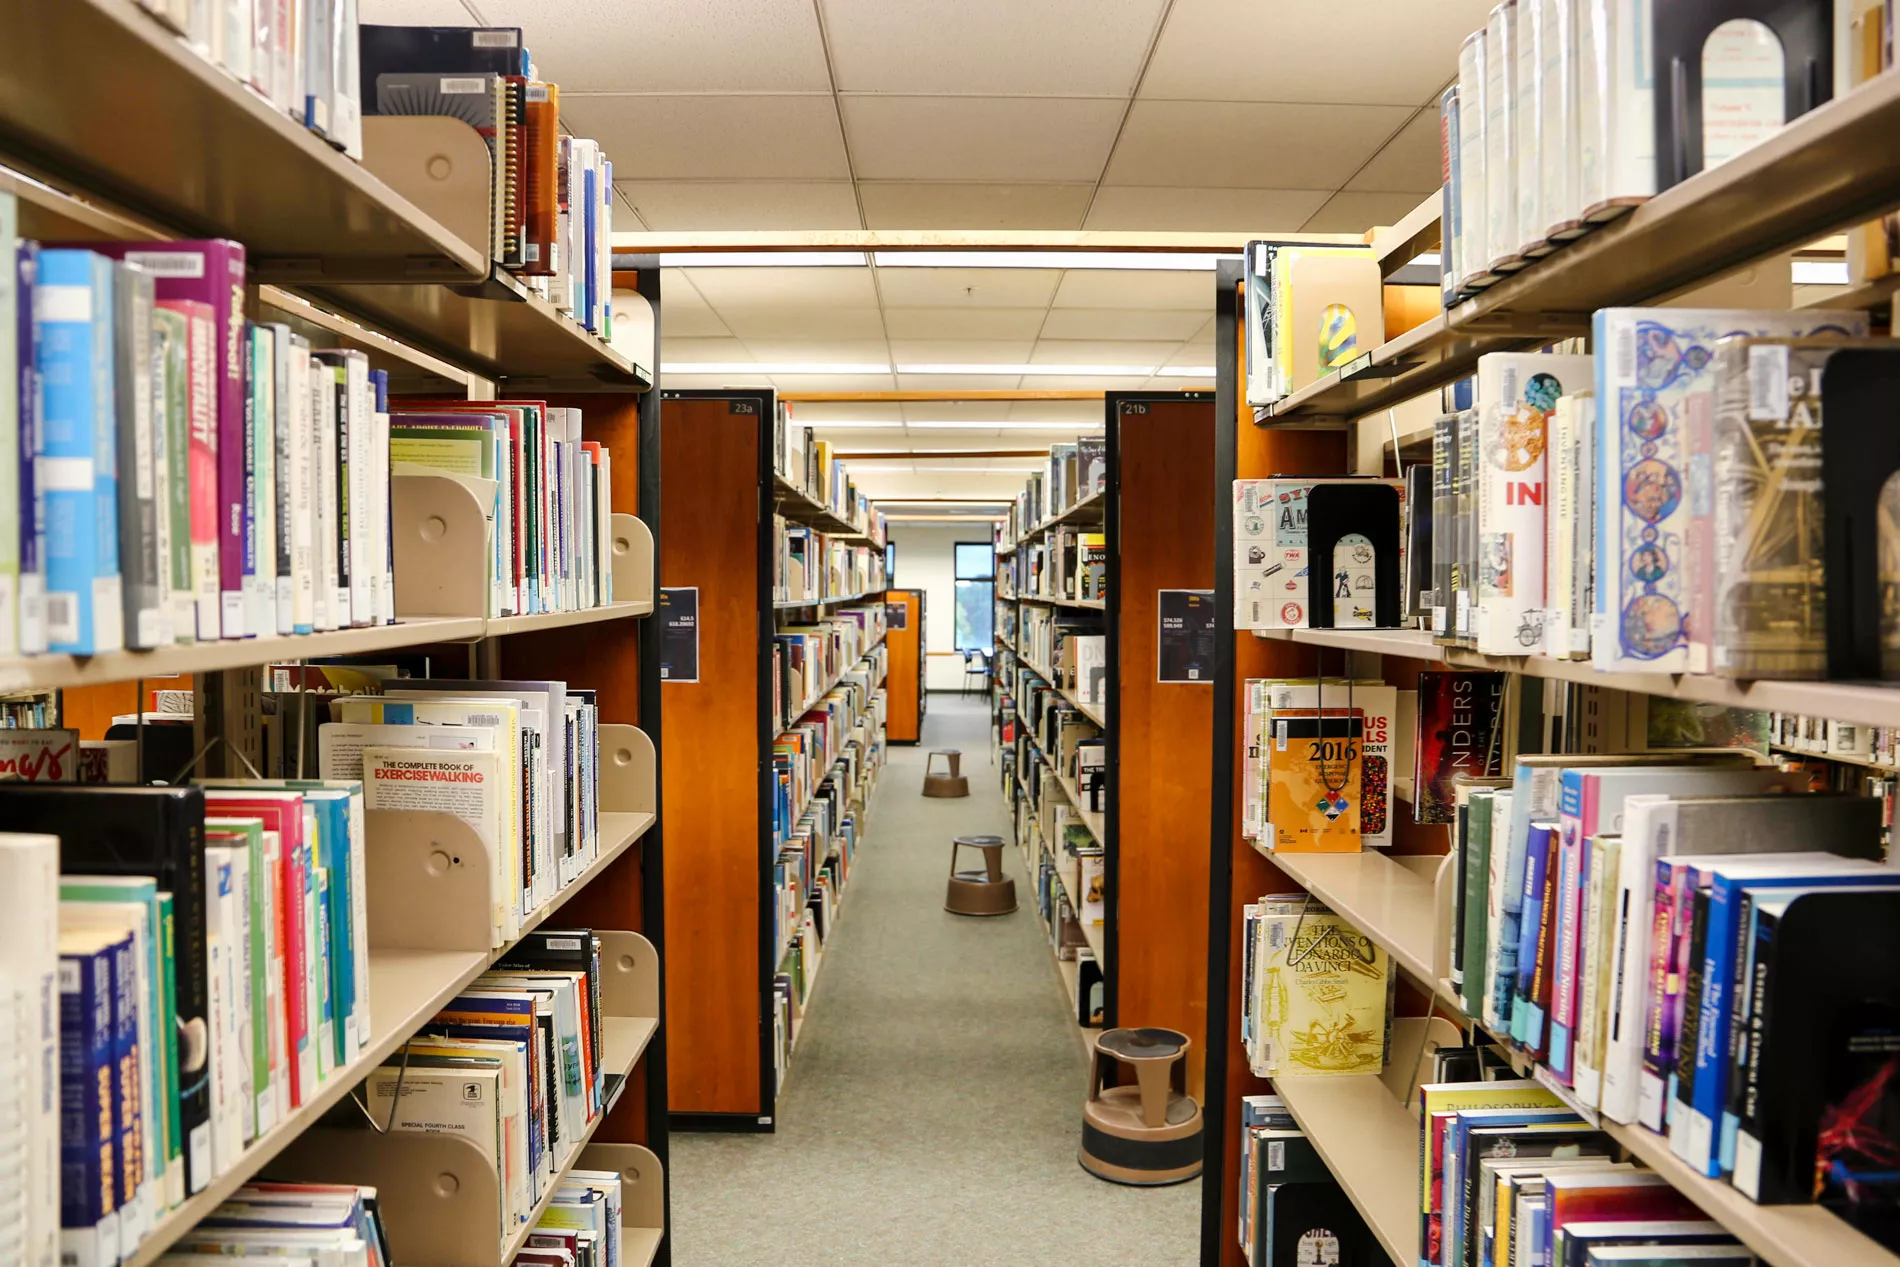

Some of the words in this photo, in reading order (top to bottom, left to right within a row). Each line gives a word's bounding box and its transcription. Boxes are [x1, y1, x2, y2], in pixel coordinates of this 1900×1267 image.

[192, 317, 208, 444] IMMORTALITY
[735, 403, 754, 414] 23a
[1125, 403, 1146, 415] 21b
[1560, 426, 1568, 494] INVENTING
[247, 476, 255, 520] OLDER
[1506, 482, 1542, 506] IN
[231, 503, 241, 537] Rose
[247, 520, 255, 569] ADULTS
[1285, 551, 1300, 559] TWA
[383, 761, 396, 769] THE
[397, 762, 437, 770] COMPLETE
[438, 763, 462, 771] BOOK
[463, 764, 474, 772] OF
[1308, 741, 1357, 762] 2016
[1362, 745, 1388, 753] IDENT
[374, 768, 484, 783] EXERCISEWALKING
[1526, 856, 1535, 895] DISASTER
[1562, 852, 1577, 926] Community
[1541, 880, 1552, 924] ADVANCED
[1312, 924, 1340, 936] THE
[1537, 925, 1547, 966] PRACTICE
[1295, 949, 1361, 960] EONARDO
[1295, 962, 1314, 972] DA
[1316, 962, 1352, 972] VINCI
[1561, 929, 1573, 973] Health
[1653, 910, 1669, 1005] EVIDENCE-BASED
[1532, 966, 1544, 1003] NURSING
[1558, 975, 1570, 1024] Nursing
[1711, 981, 1722, 1004] The
[1754, 962, 1767, 1014] CULTURE
[41, 972, 55, 1041] Personal
[483, 1017, 505, 1025] Everyone
[1753, 1016, 1763, 1029] &
[1650, 1006, 1663, 1057] NURSING
[1697, 1006, 1711, 1069] Handbook
[1748, 1031, 1762, 1083] CLINICAL
[43, 1046, 55, 1116] Nutrition
[120, 1059, 133, 1129] SUPER
[98, 1066, 112, 1141] SUPER
[1445, 1102, 1542, 1111] PHILOSOPHY
[1746, 1085, 1759, 1118] CARE
[401, 1121, 423, 1129] SPECIAL
[100, 1143, 114, 1215] BRAIN
[122, 1133, 136, 1203] BRAIN
[1464, 1178, 1472, 1198] THE
